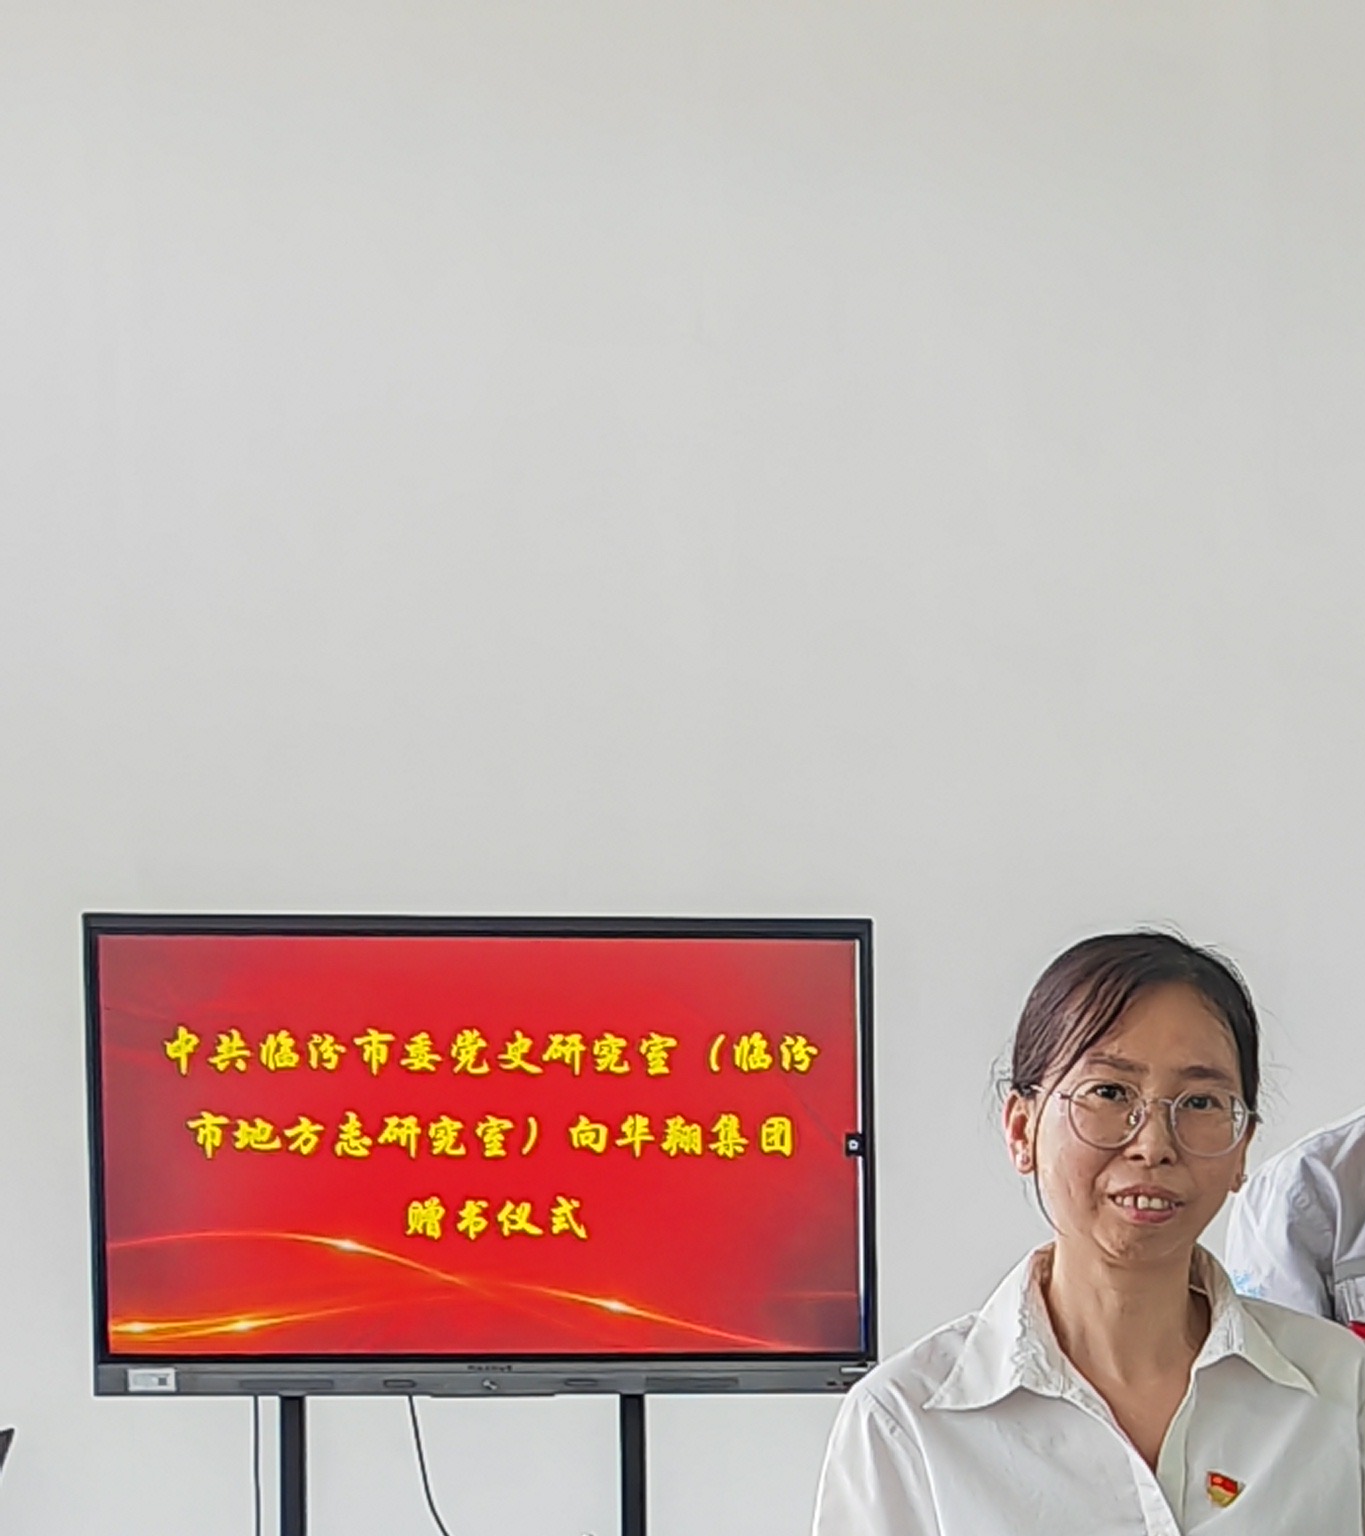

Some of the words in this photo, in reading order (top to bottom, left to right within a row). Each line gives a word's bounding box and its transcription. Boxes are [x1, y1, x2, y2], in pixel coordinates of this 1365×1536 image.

[163, 1025, 819, 1077] 中共临汾市委党史研究室（临汾
[185, 1110, 795, 1160] 市地方志研究室）向华翔集团
[404, 1194, 589, 1241] 赠书仪式
